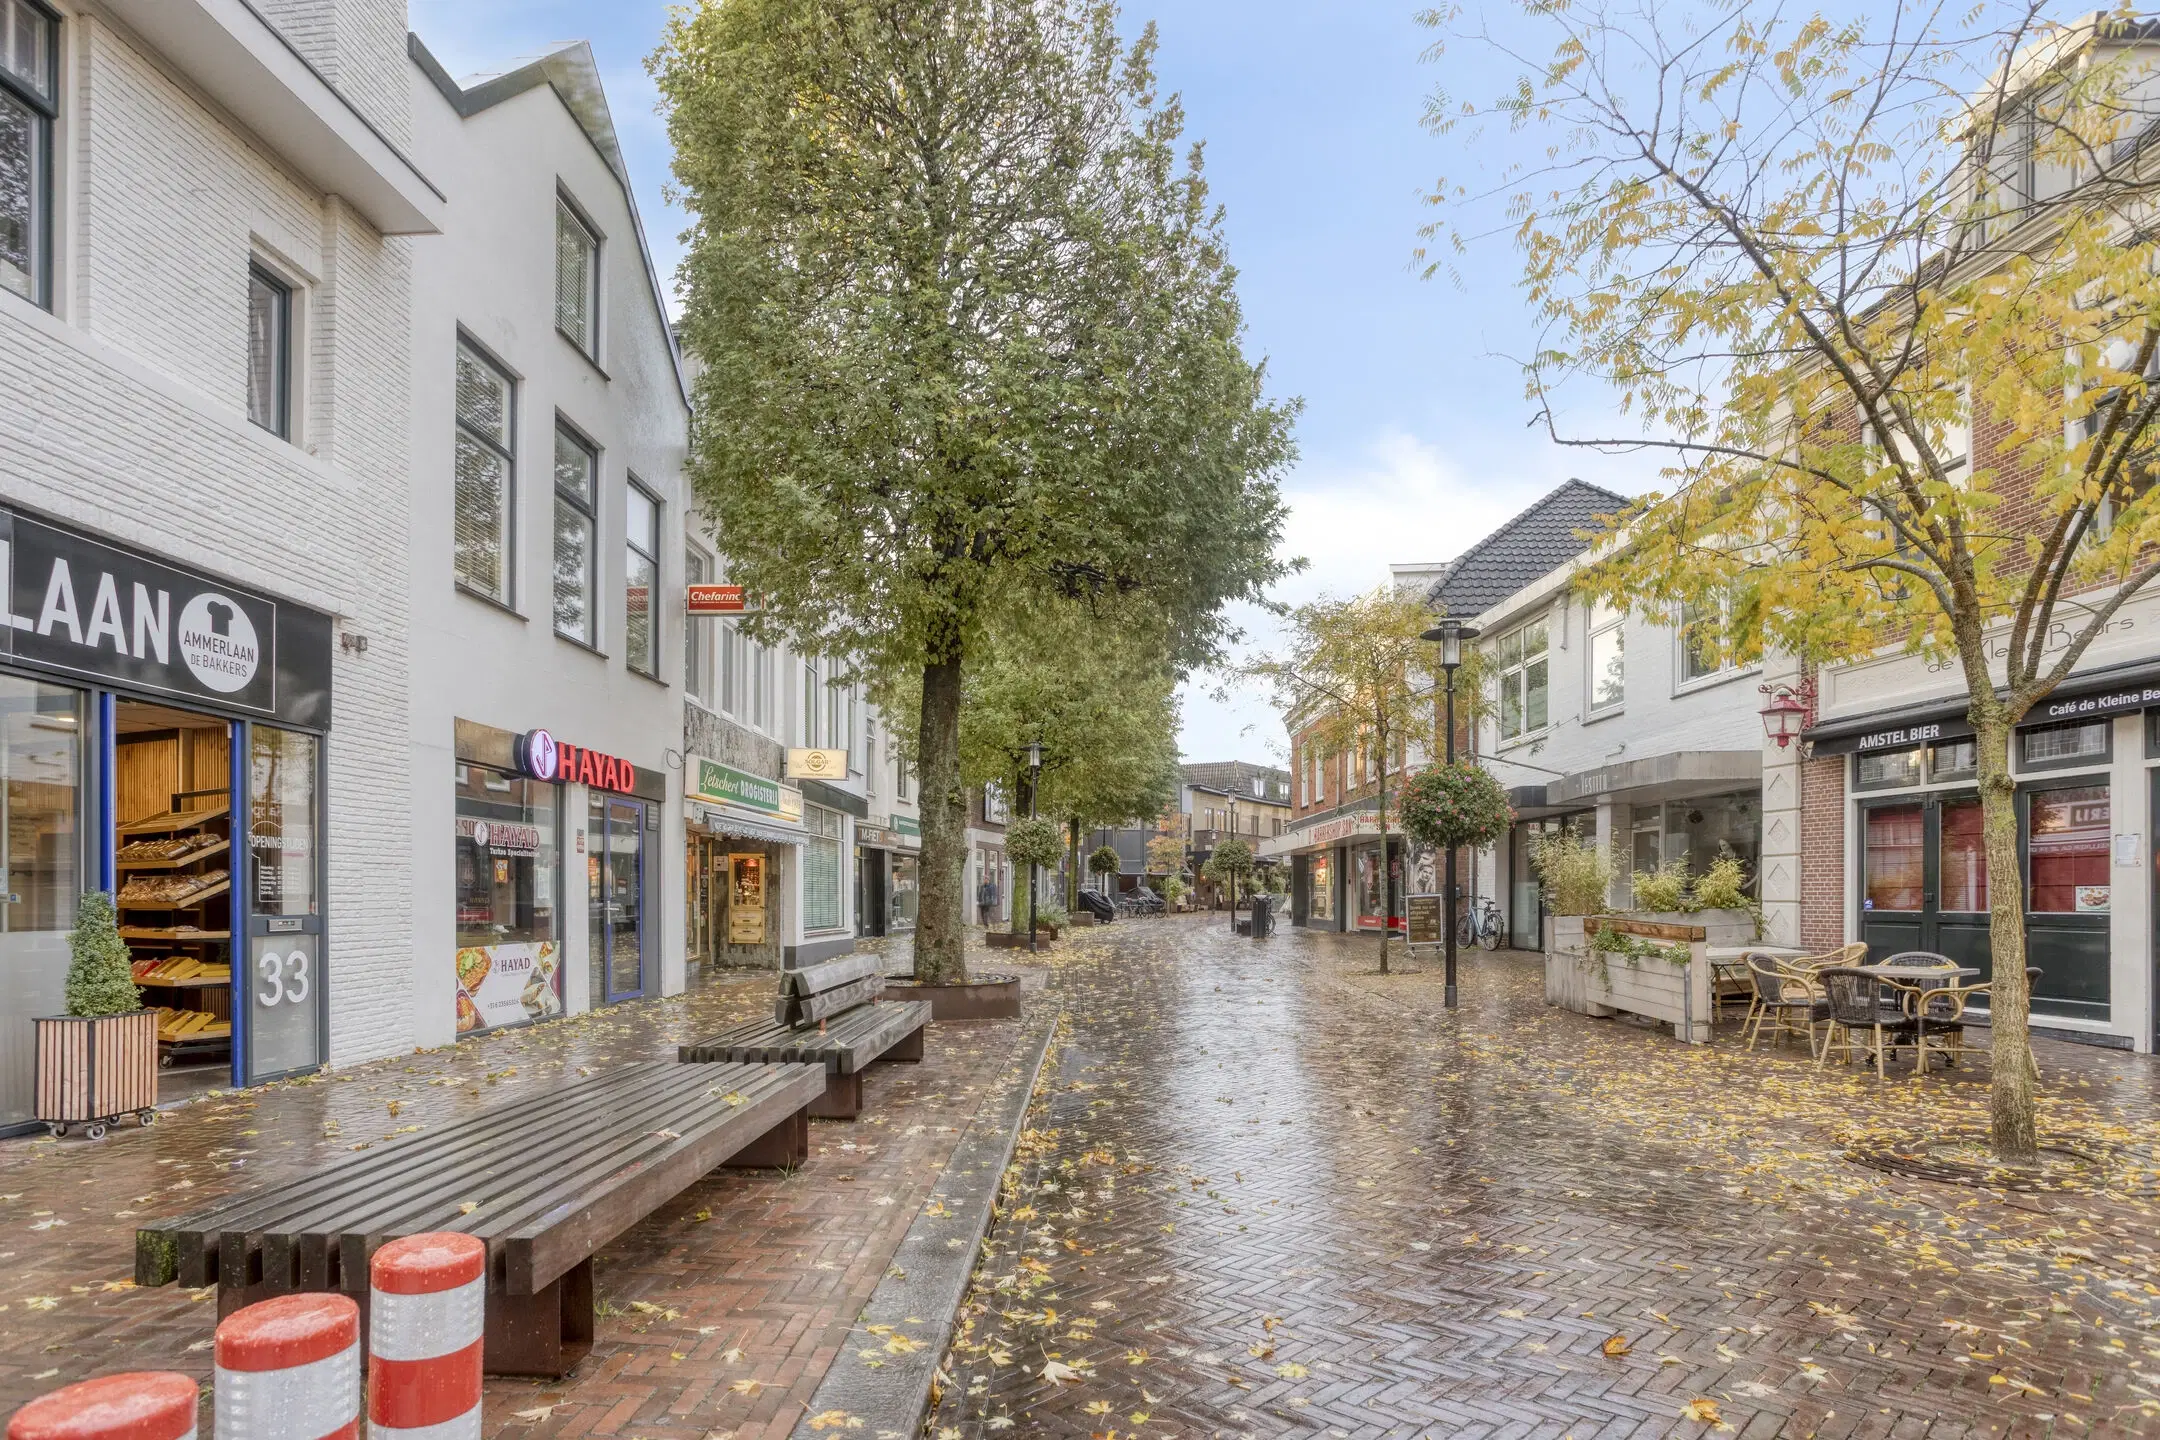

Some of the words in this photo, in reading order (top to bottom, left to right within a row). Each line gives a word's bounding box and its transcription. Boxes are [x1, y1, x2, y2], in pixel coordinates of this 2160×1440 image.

[184, 630, 254, 663] AMMERLAAN
[191, 653, 200, 667] DE
[203, 656, 247, 678] BAKKERS
[1927, 660, 1954, 673] de
[2049, 702, 2076, 716] Café
[2079, 700, 2095, 711] de
[2098, 694, 2140, 709] Kleine
[1859, 730, 1907, 749] AMSTEL
[1910, 724, 1939, 740] BIER
[557, 741, 635, 794] HAYAD
[701, 764, 739, 795] Letschert
[740, 779, 778, 806] DROGISTERIJ
[489, 823, 541, 848] HAYAD
[501, 958, 531, 972] HAYAD
[259, 950, 309, 1007] 33
